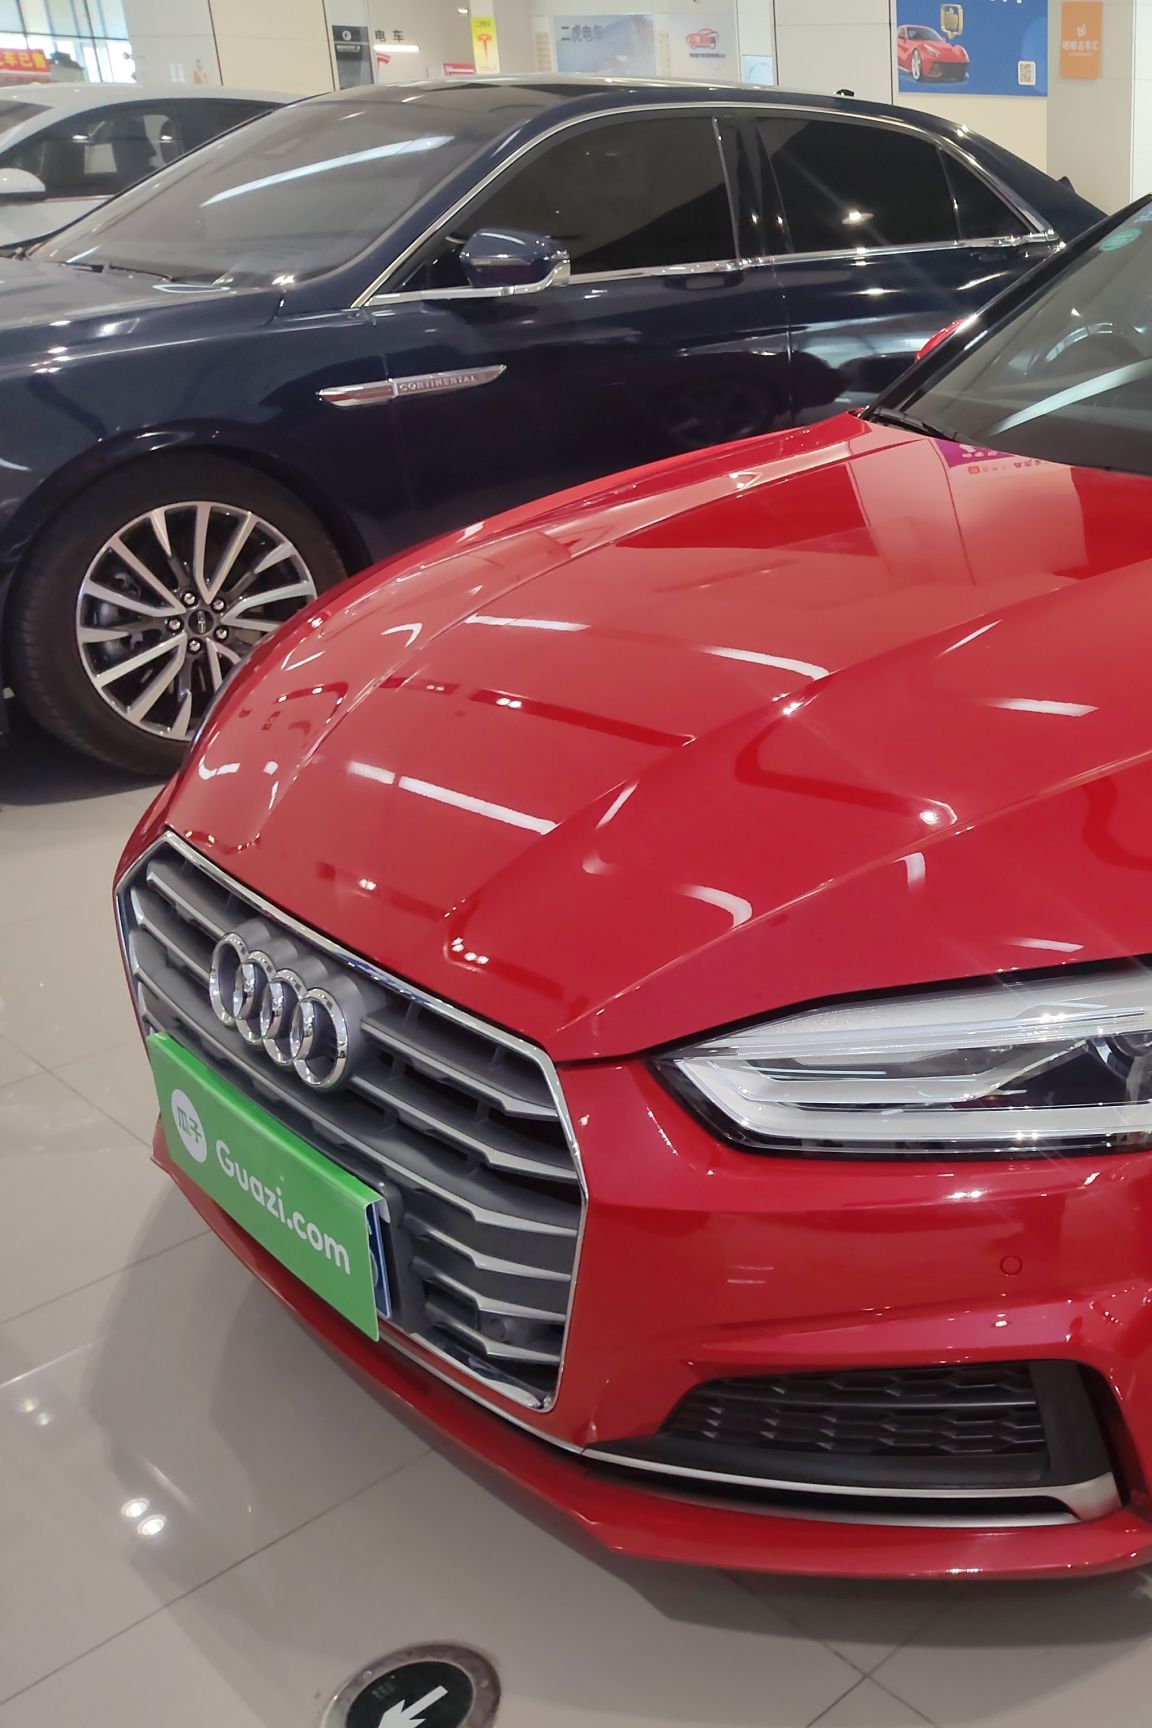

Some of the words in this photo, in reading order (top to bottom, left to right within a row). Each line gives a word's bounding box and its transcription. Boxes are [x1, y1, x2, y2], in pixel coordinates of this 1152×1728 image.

[399, 375, 477, 392] CONTINENTAL
[176, 1106, 203, 1144] 瓜子
[215, 1139, 352, 1275] Guazi.com
